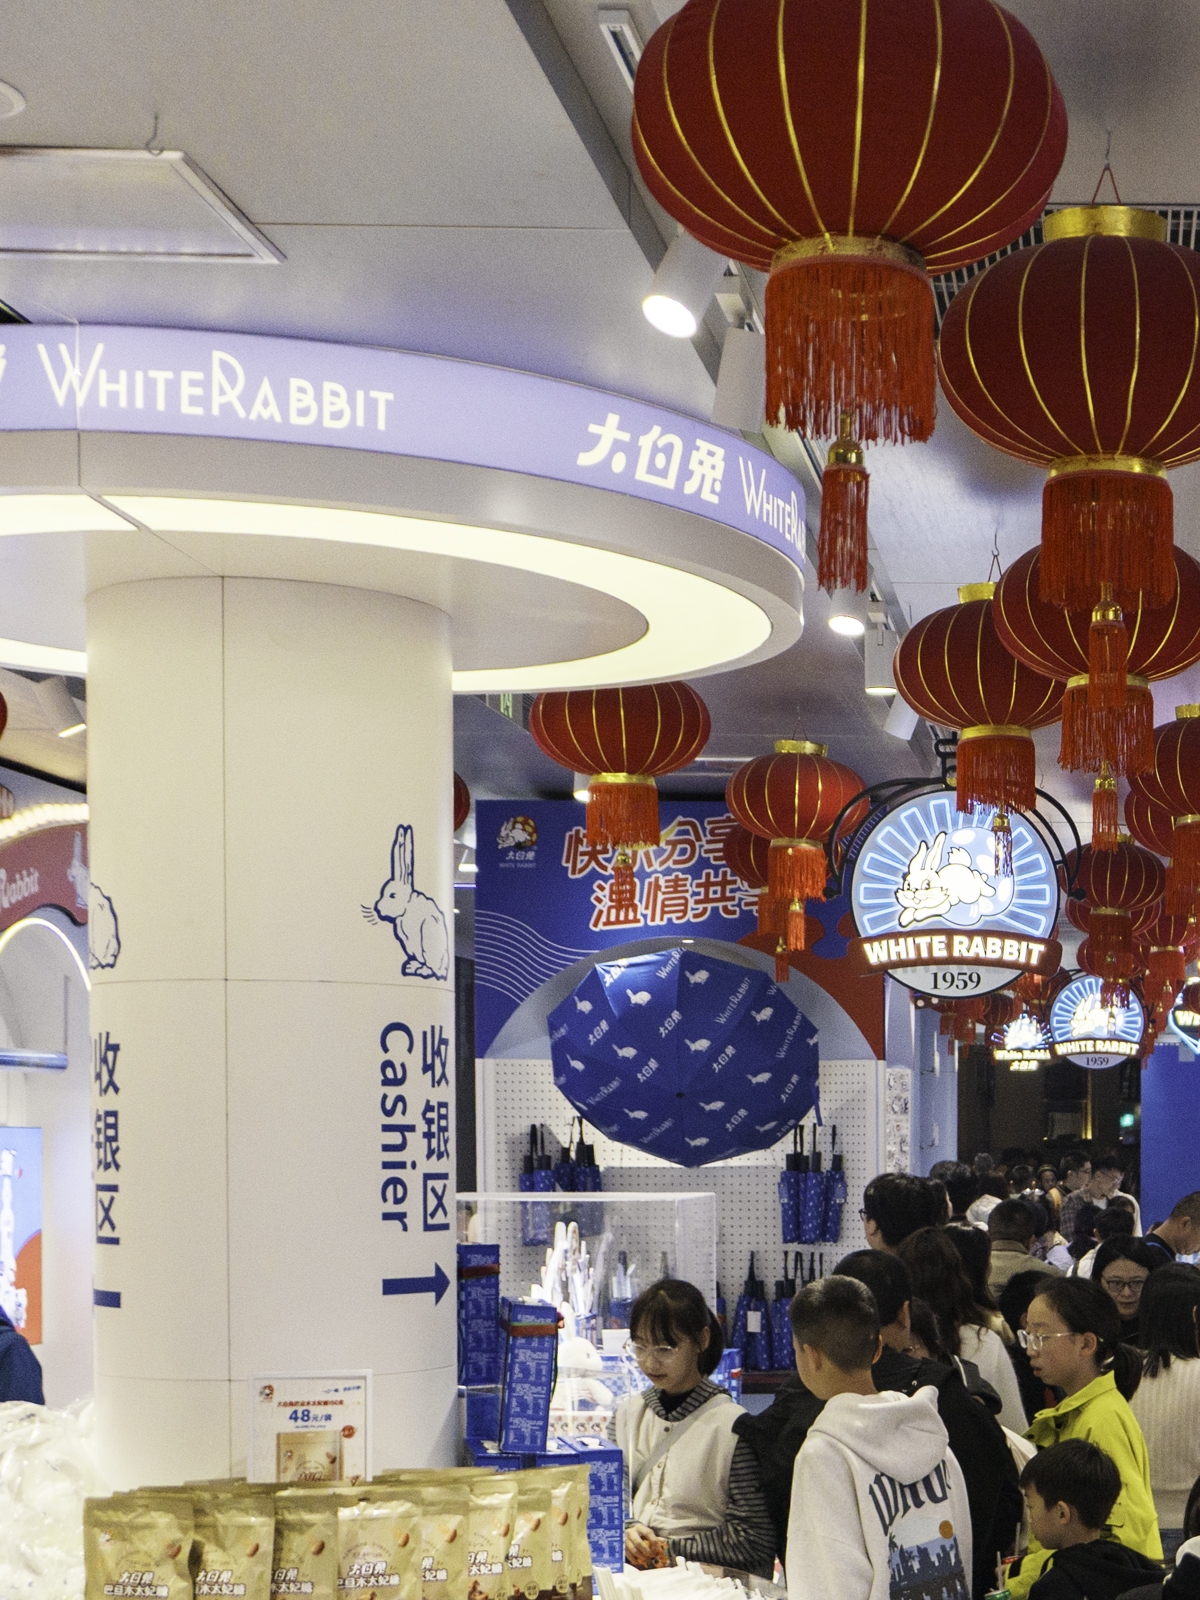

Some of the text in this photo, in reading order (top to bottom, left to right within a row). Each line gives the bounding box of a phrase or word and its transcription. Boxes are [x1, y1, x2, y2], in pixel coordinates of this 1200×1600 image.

[576, 412, 725, 504] 大白兔
[863, 935, 1045, 966] WHITE RABBIT
[930, 971, 981, 990] 1959
[659, 1009, 682, 1038] 大白兔
[712, 1044, 736, 1073] 大白兔
[1055, 1040, 1140, 1056] WHITE RABBIT
[1086, 1056, 1109, 1066] 1959
[380, 1022, 418, 1232] Cashier
[421, 1024, 451, 1232] 收银区
[118, 1570, 155, 1584] 大白兔
[349, 1561, 387, 1576] 大白兔
